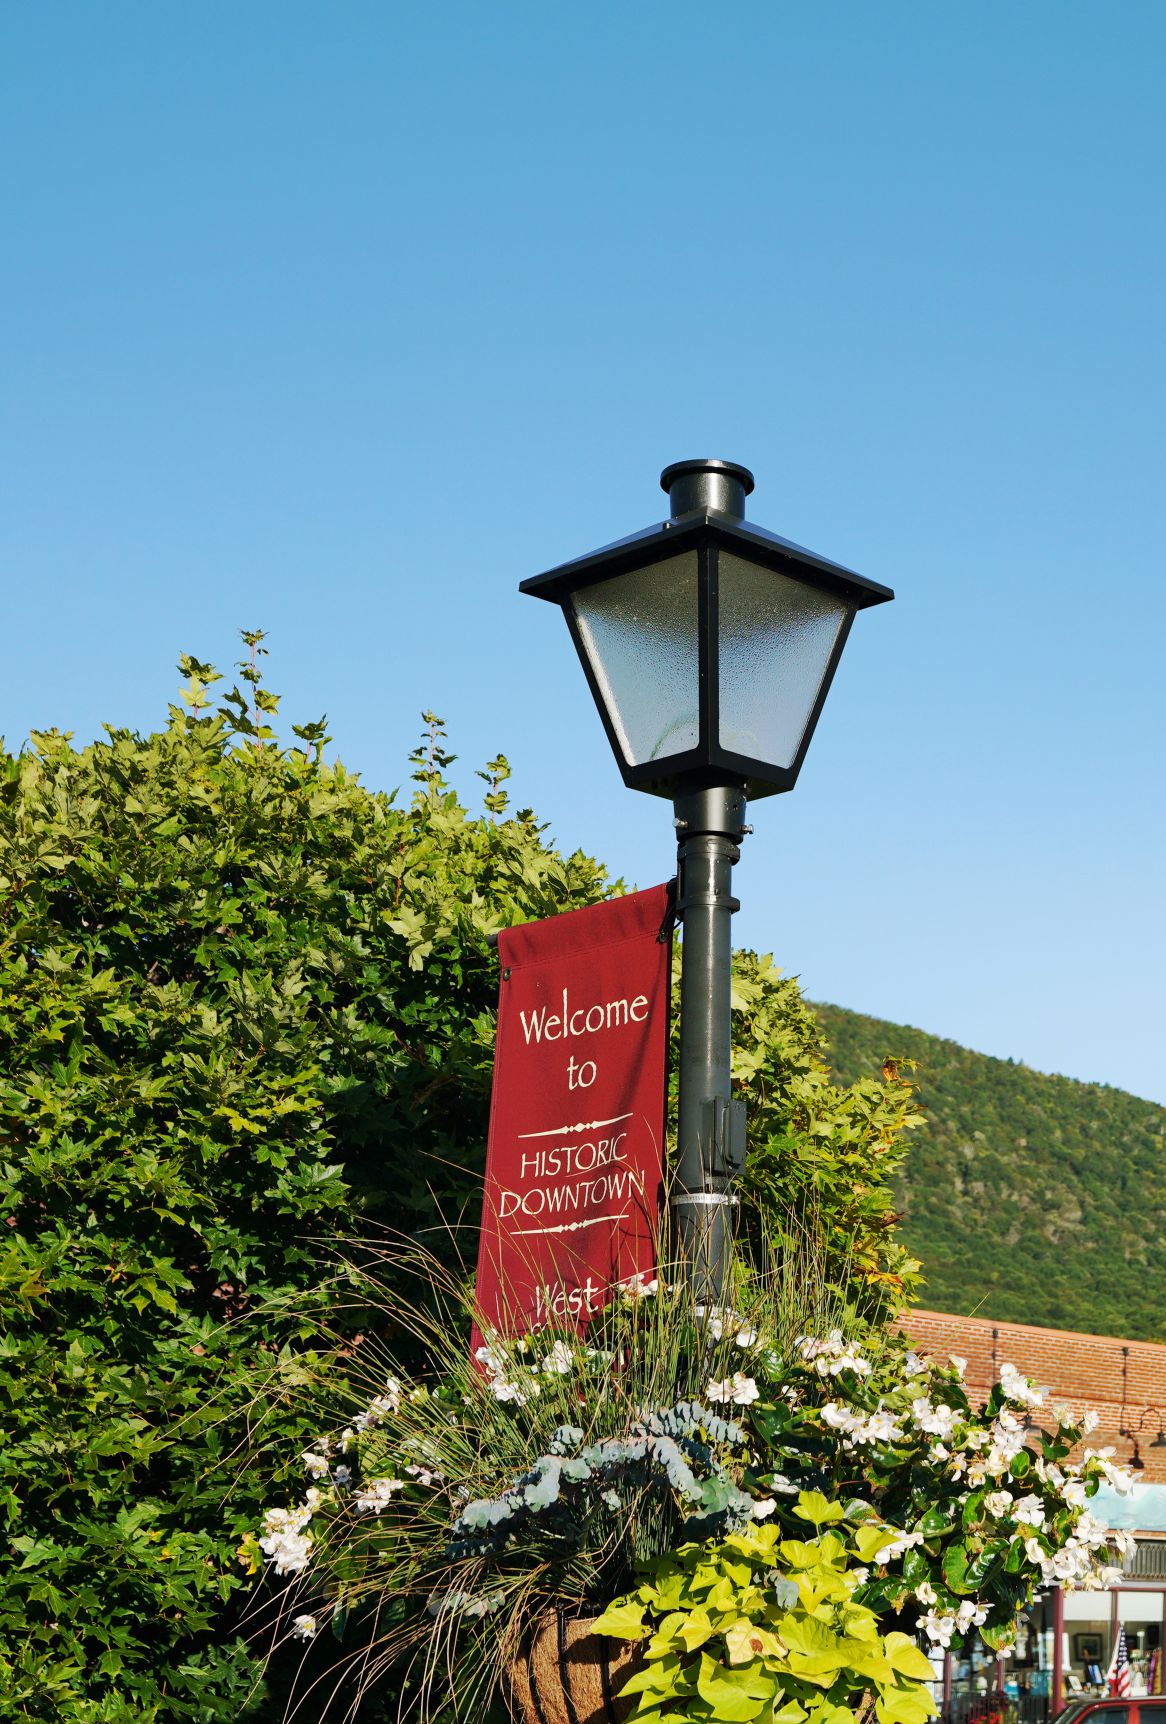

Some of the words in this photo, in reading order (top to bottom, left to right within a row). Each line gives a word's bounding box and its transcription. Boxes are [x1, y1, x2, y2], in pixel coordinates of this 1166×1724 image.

[520, 987, 648, 1045] Welcome
[566, 1055, 597, 1090] to
[520, 1132, 628, 1179] HISTORIC
[498, 1169, 645, 1218] DOWNTOWN
[535, 1276, 599, 1320] West
